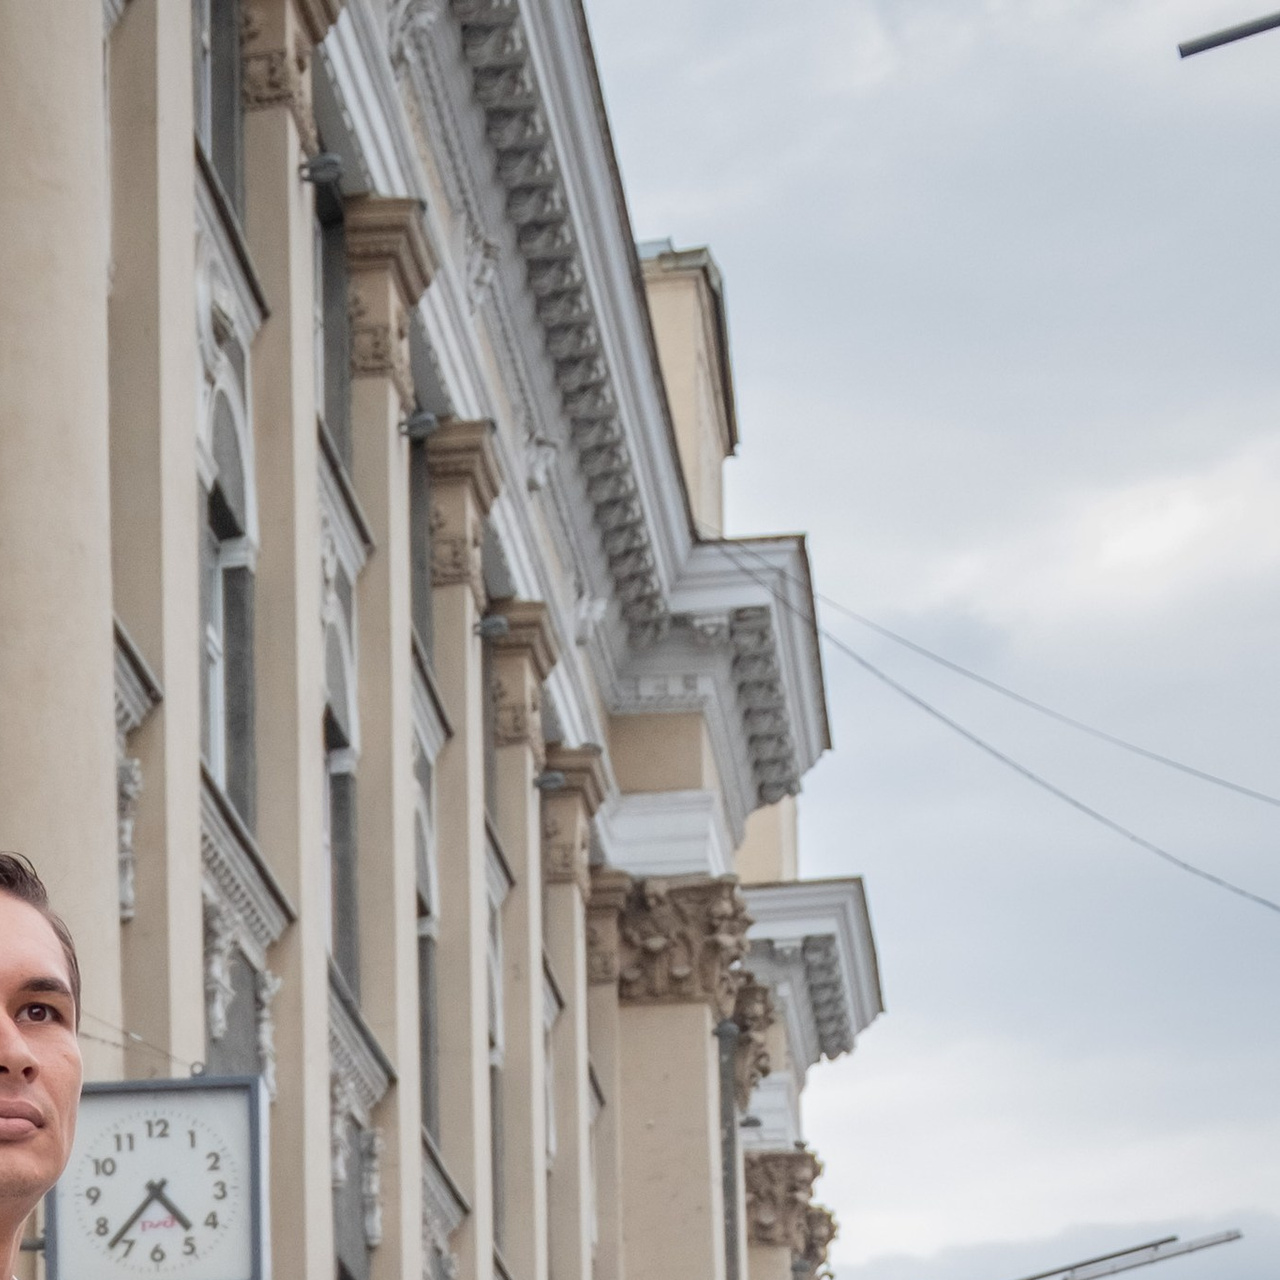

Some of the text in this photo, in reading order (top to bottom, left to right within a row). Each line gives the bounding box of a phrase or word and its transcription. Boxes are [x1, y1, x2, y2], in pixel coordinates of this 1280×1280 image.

[145, 1118, 169, 1138] 12
[114, 1133, 135, 1151] 11
[187, 1130, 196, 1148] 1
[93, 1157, 116, 1177] 10
[206, 1152, 221, 1171] 2
[85, 1186, 101, 1205] 9
[213, 1181, 228, 1200] 3
[95, 1217, 109, 1237] 8
[204, 1211, 219, 1230] 4
[121, 1239, 136, 1258] 7
[149, 1244, 166, 1263] 6
[183, 1236, 196, 1256] 5
